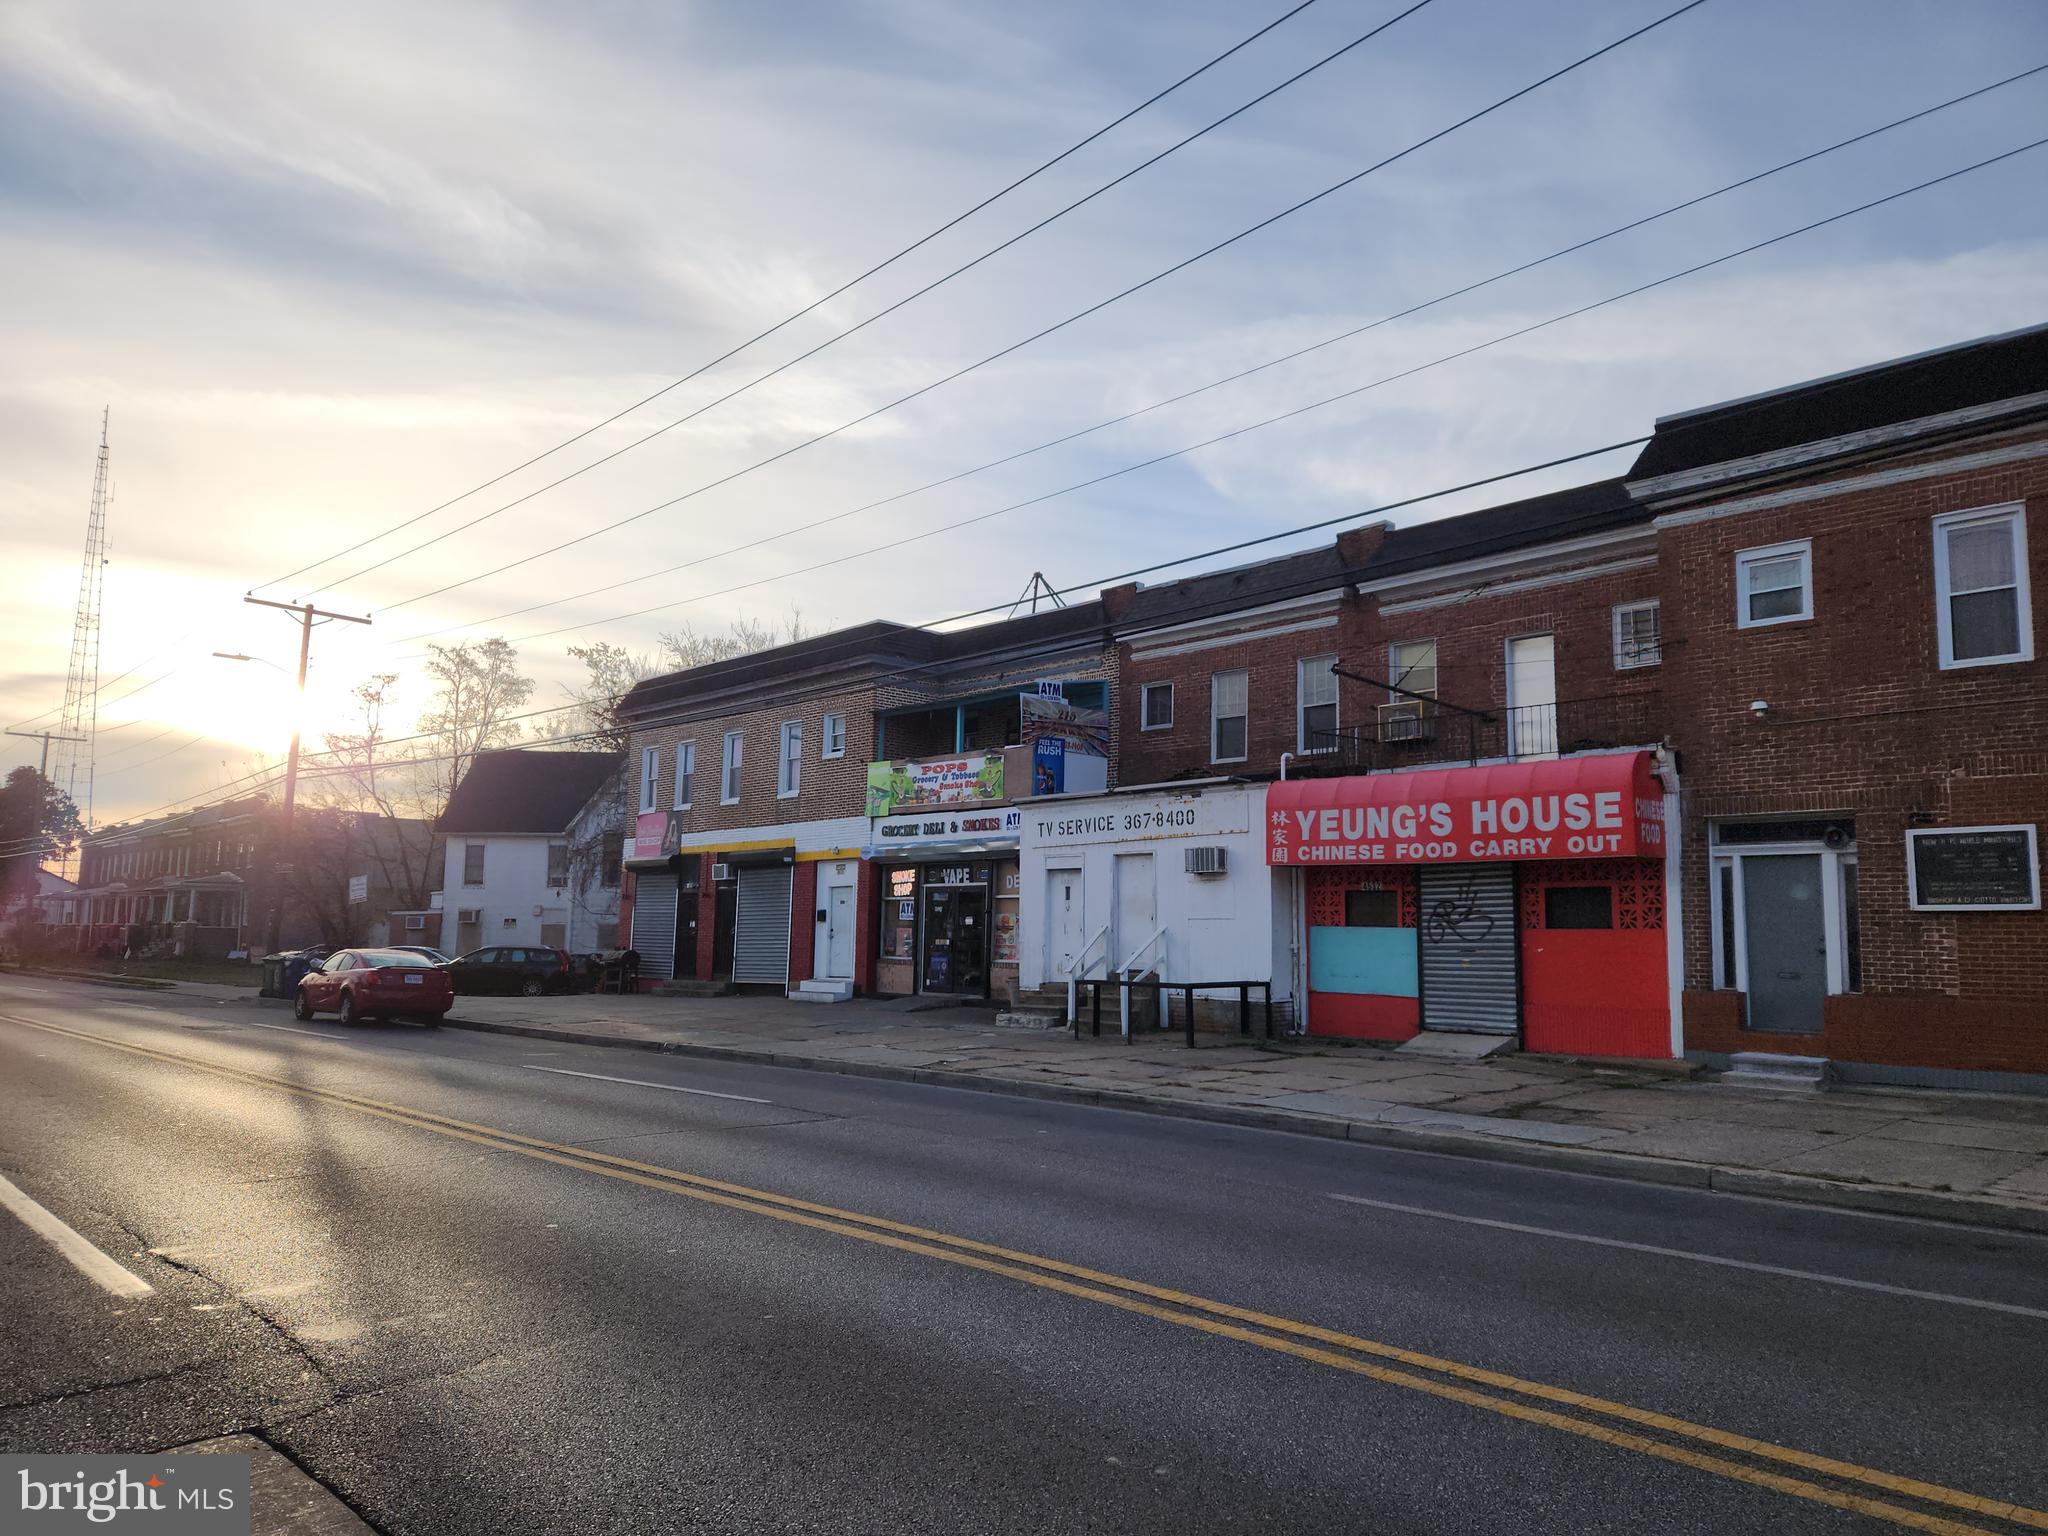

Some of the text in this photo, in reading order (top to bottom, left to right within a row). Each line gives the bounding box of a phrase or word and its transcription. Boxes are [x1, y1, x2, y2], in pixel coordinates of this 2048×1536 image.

[1040, 682, 1061, 696] ATM
[1039, 738, 1051, 746] FEEL
[1038, 745, 1062, 756] RUSH
[921, 762, 968, 775] POPS
[912, 775, 939, 783] Grocery
[1295, 791, 1623, 841] YEUNG'S HOUSE
[1635, 798, 1665, 821] CHINESE
[881, 824, 919, 837] GROCERY
[923, 821, 945, 835] DELI
[950, 821, 958, 833] &
[962, 817, 1001, 832] SMOKES
[1037, 821, 1053, 838] TV
[1058, 815, 1115, 836] SERVICE
[1641, 824, 1661, 844] FOOD
[1297, 834, 1622, 861] CHINESE FOOD CARRY OUT
[891, 869, 915, 884] SMOKE
[943, 868, 970, 884] VAPE
[893, 882, 913, 897] SHOP
